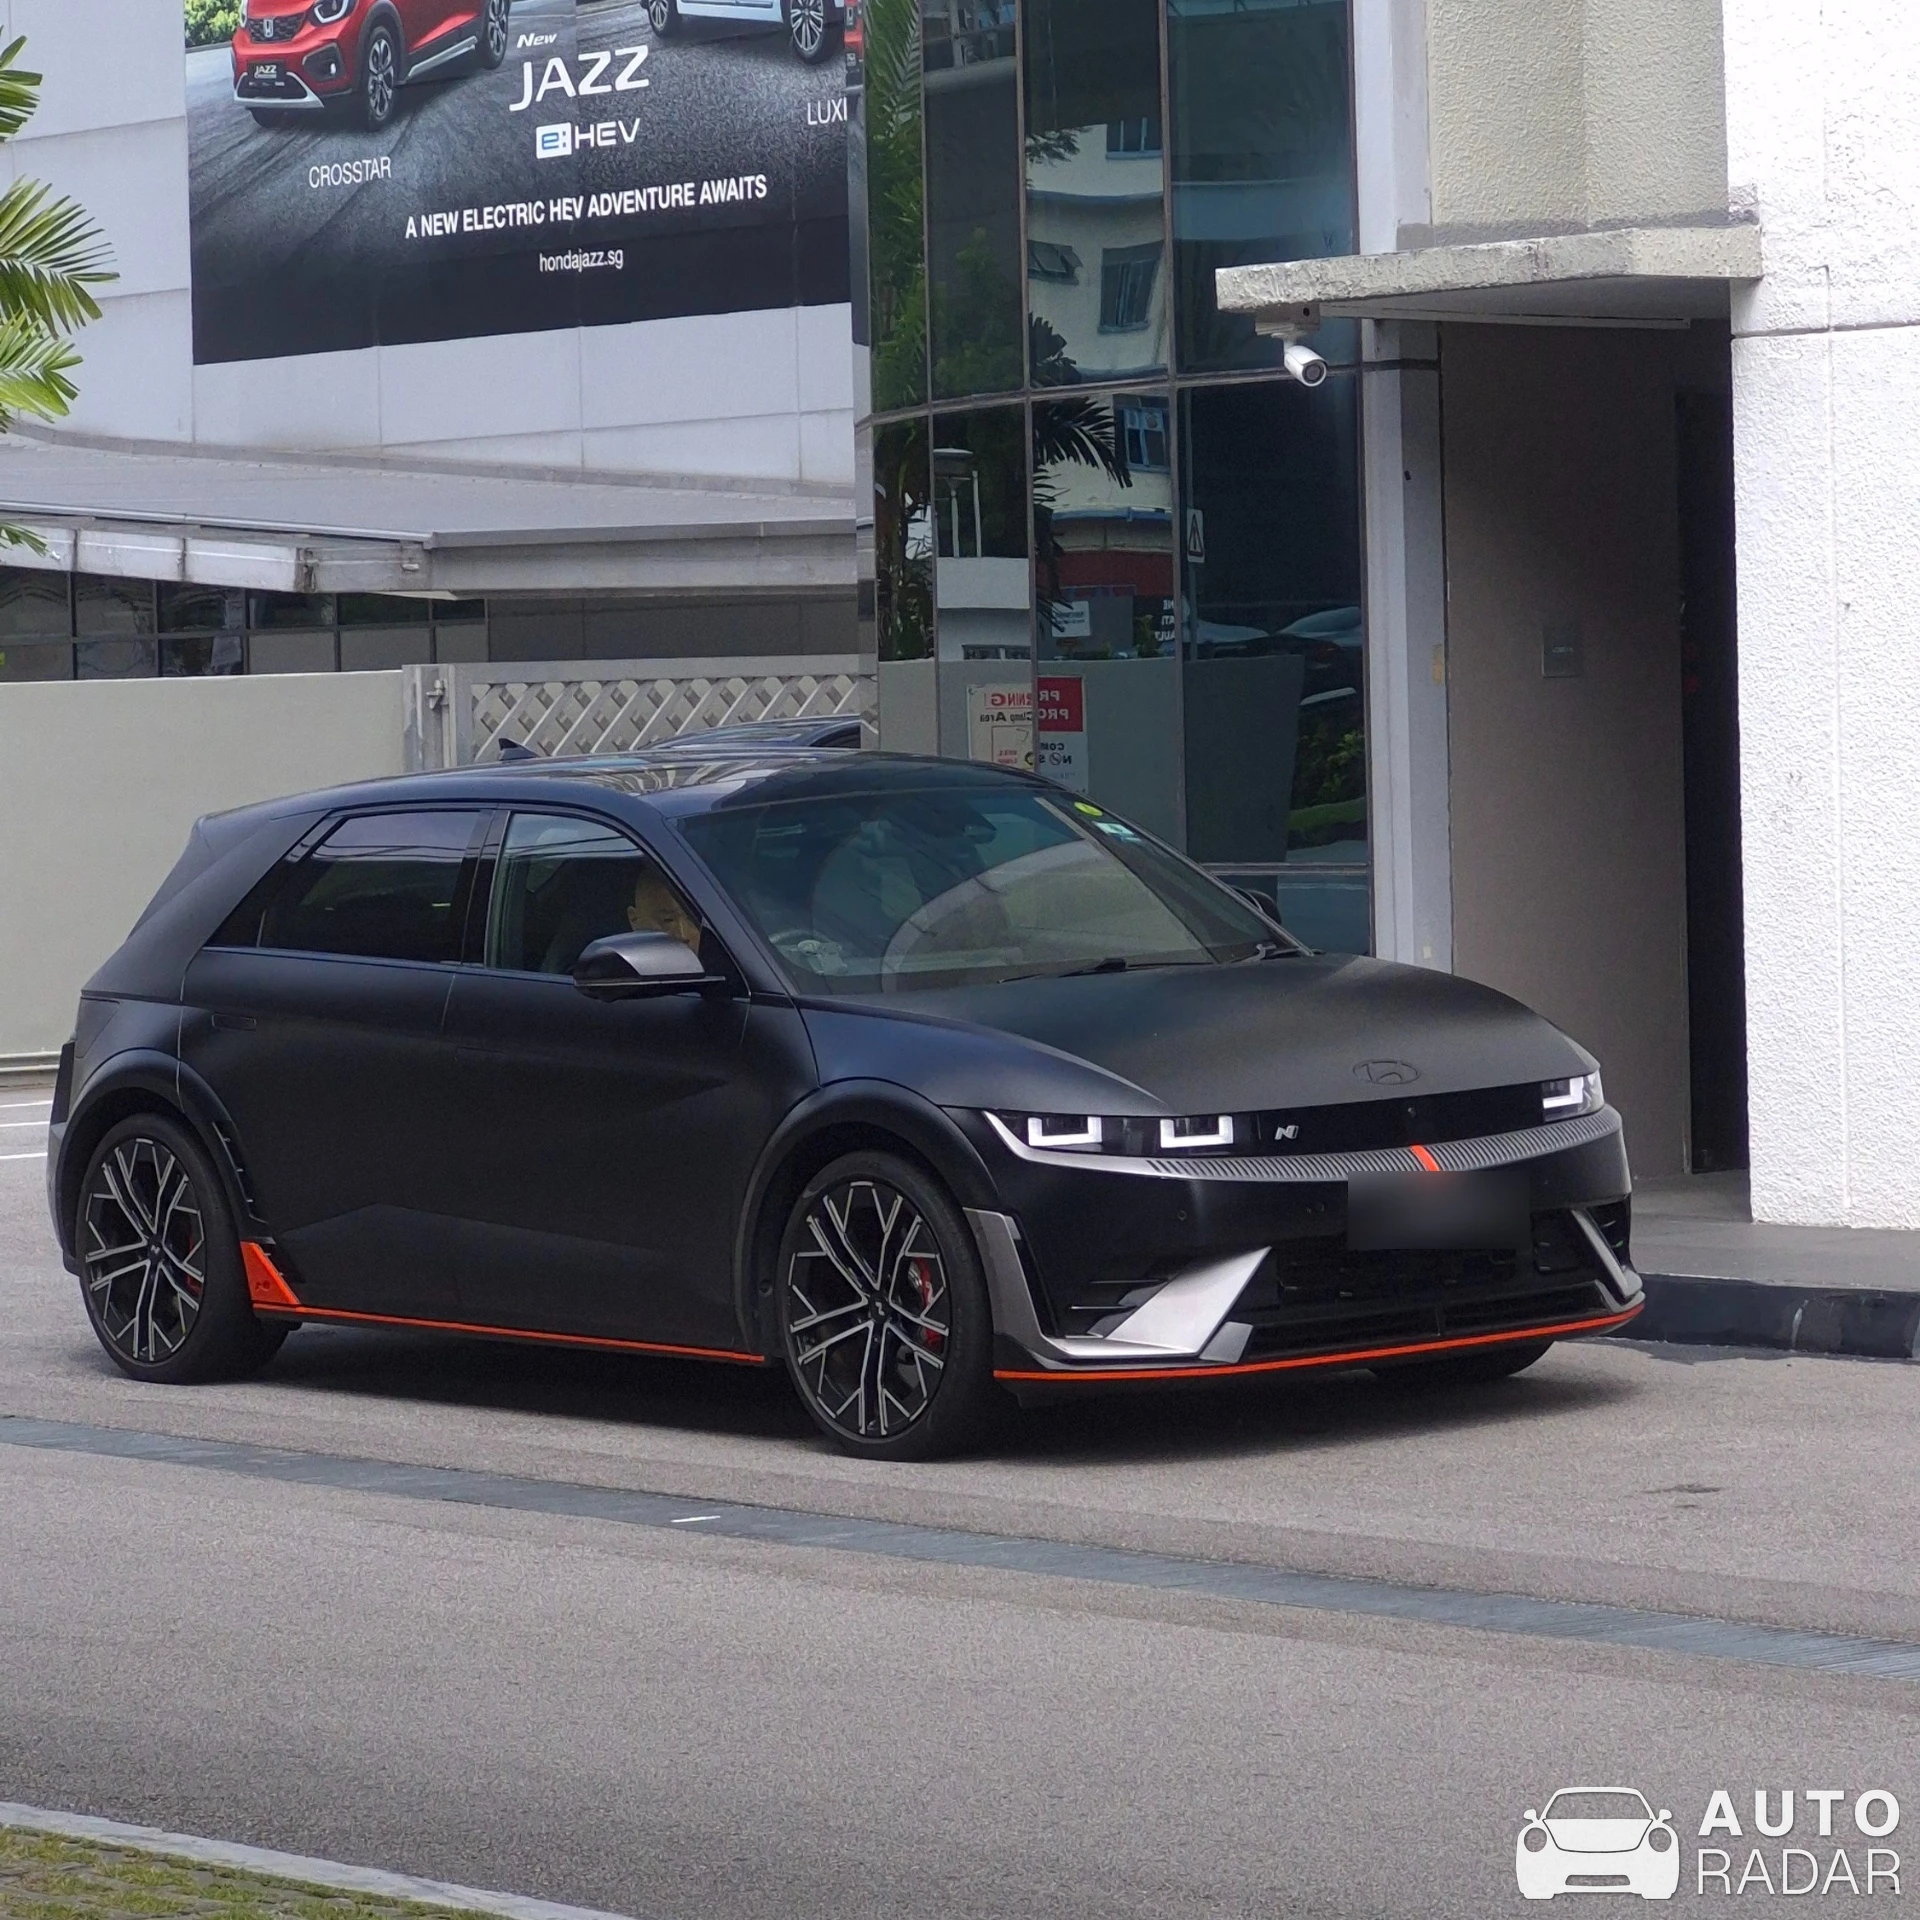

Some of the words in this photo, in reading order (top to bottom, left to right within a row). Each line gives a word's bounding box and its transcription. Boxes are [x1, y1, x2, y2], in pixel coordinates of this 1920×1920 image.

[516, 32, 558, 49] New
[254, 64, 277, 75] JAZZ
[508, 44, 650, 112] JAZZ
[308, 156, 392, 189] CROSSTAR
[405, 216, 418, 239] A
[420, 211, 459, 237] NEW
[462, 200, 546, 232] ELECTRIC
[549, 195, 584, 222] HEV
[587, 182, 696, 218] ADVENTURE
[699, 174, 768, 205] AWAITS
[539, 249, 624, 273] hondajazz.sg
